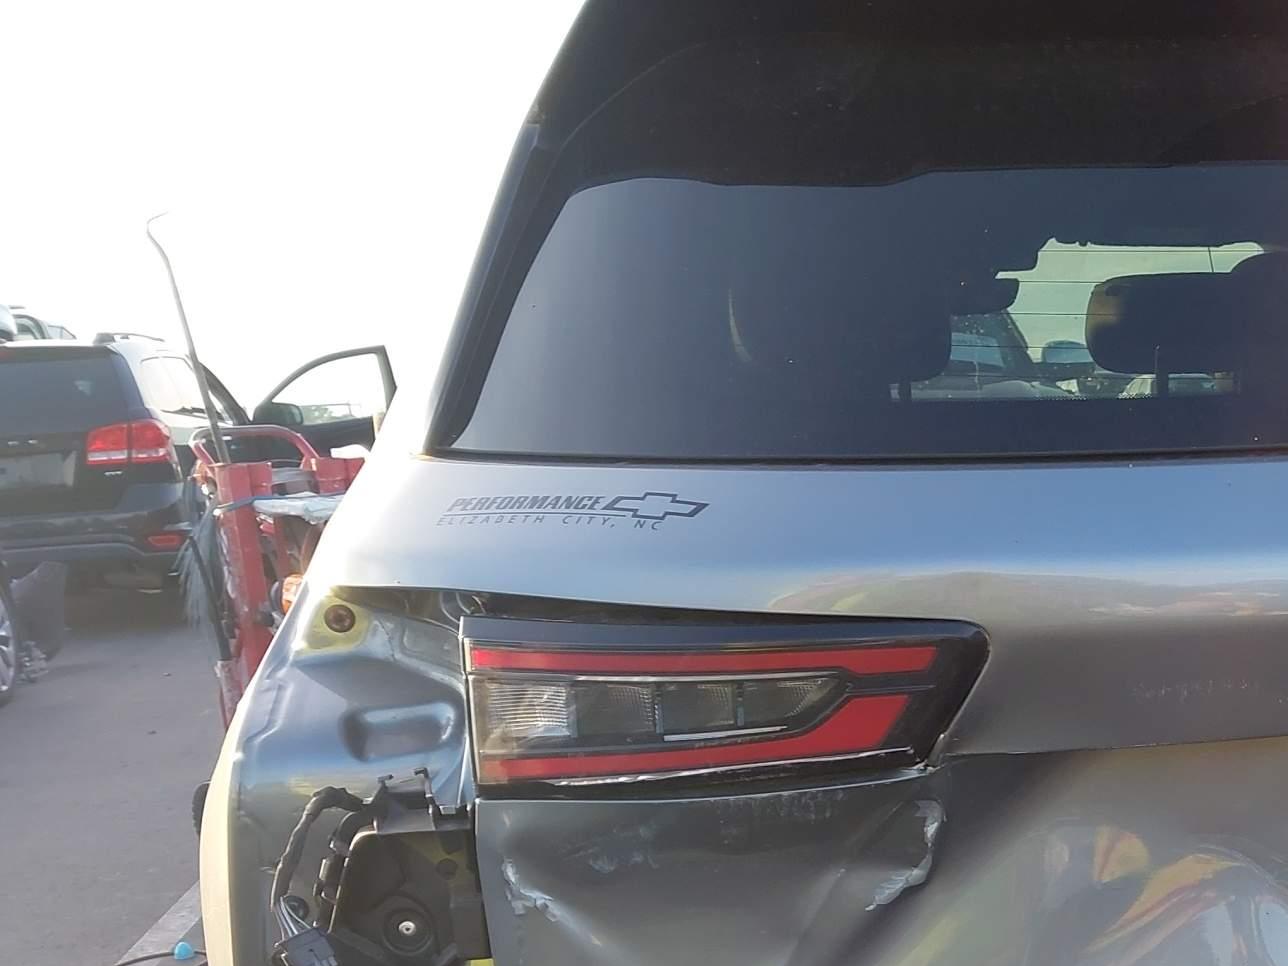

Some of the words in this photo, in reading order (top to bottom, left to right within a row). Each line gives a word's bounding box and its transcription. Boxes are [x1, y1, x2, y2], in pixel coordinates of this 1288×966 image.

[447, 495, 606, 513] PERFORMANCE
[436, 514, 545, 527] ELIZABETH
[562, 515, 616, 528] CITY,
[634, 520, 665, 531] NC
